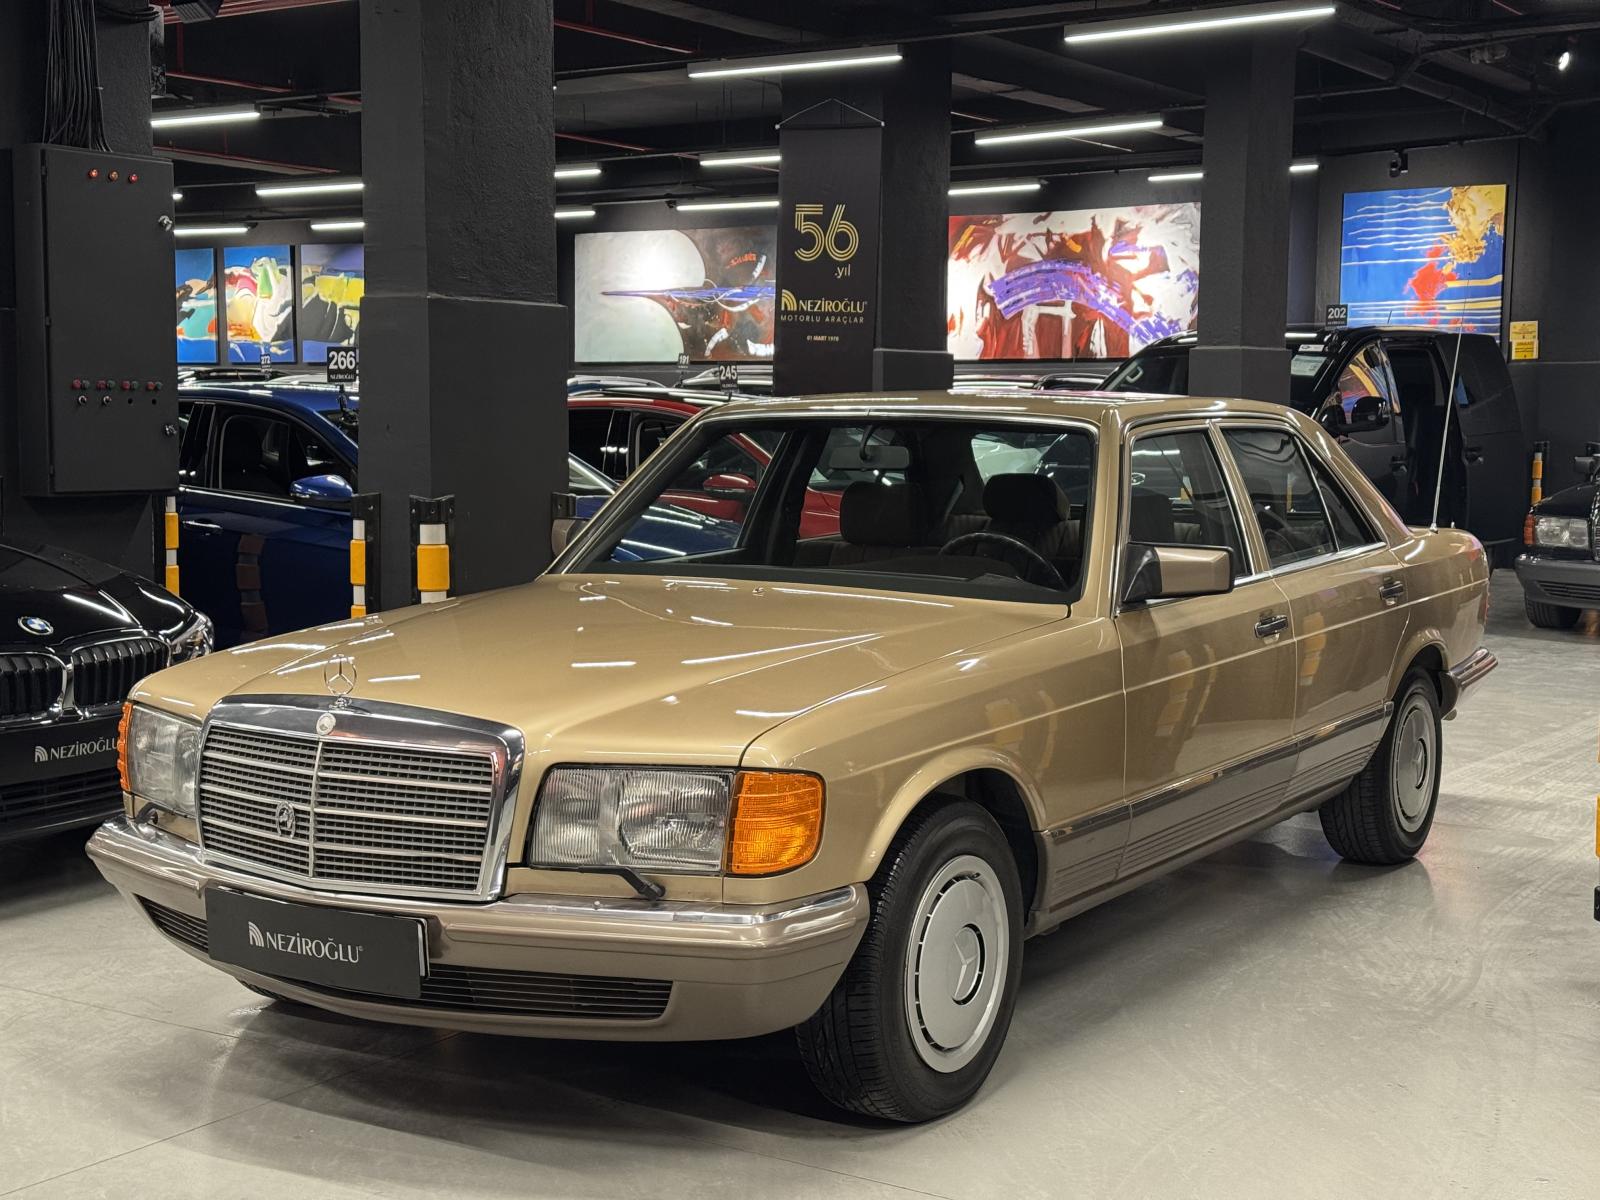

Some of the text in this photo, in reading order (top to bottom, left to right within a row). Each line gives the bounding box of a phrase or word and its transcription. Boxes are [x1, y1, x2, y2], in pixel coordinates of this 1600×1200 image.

[795, 204, 859, 261] 56
[780, 314, 865, 325] MOTORLU ARAÇLAR
[1328, 307, 1347, 319] 202
[328, 351, 356, 370] 266
[720, 365, 738, 380] 245
[266, 931, 360, 963] NEZİROĞLU
